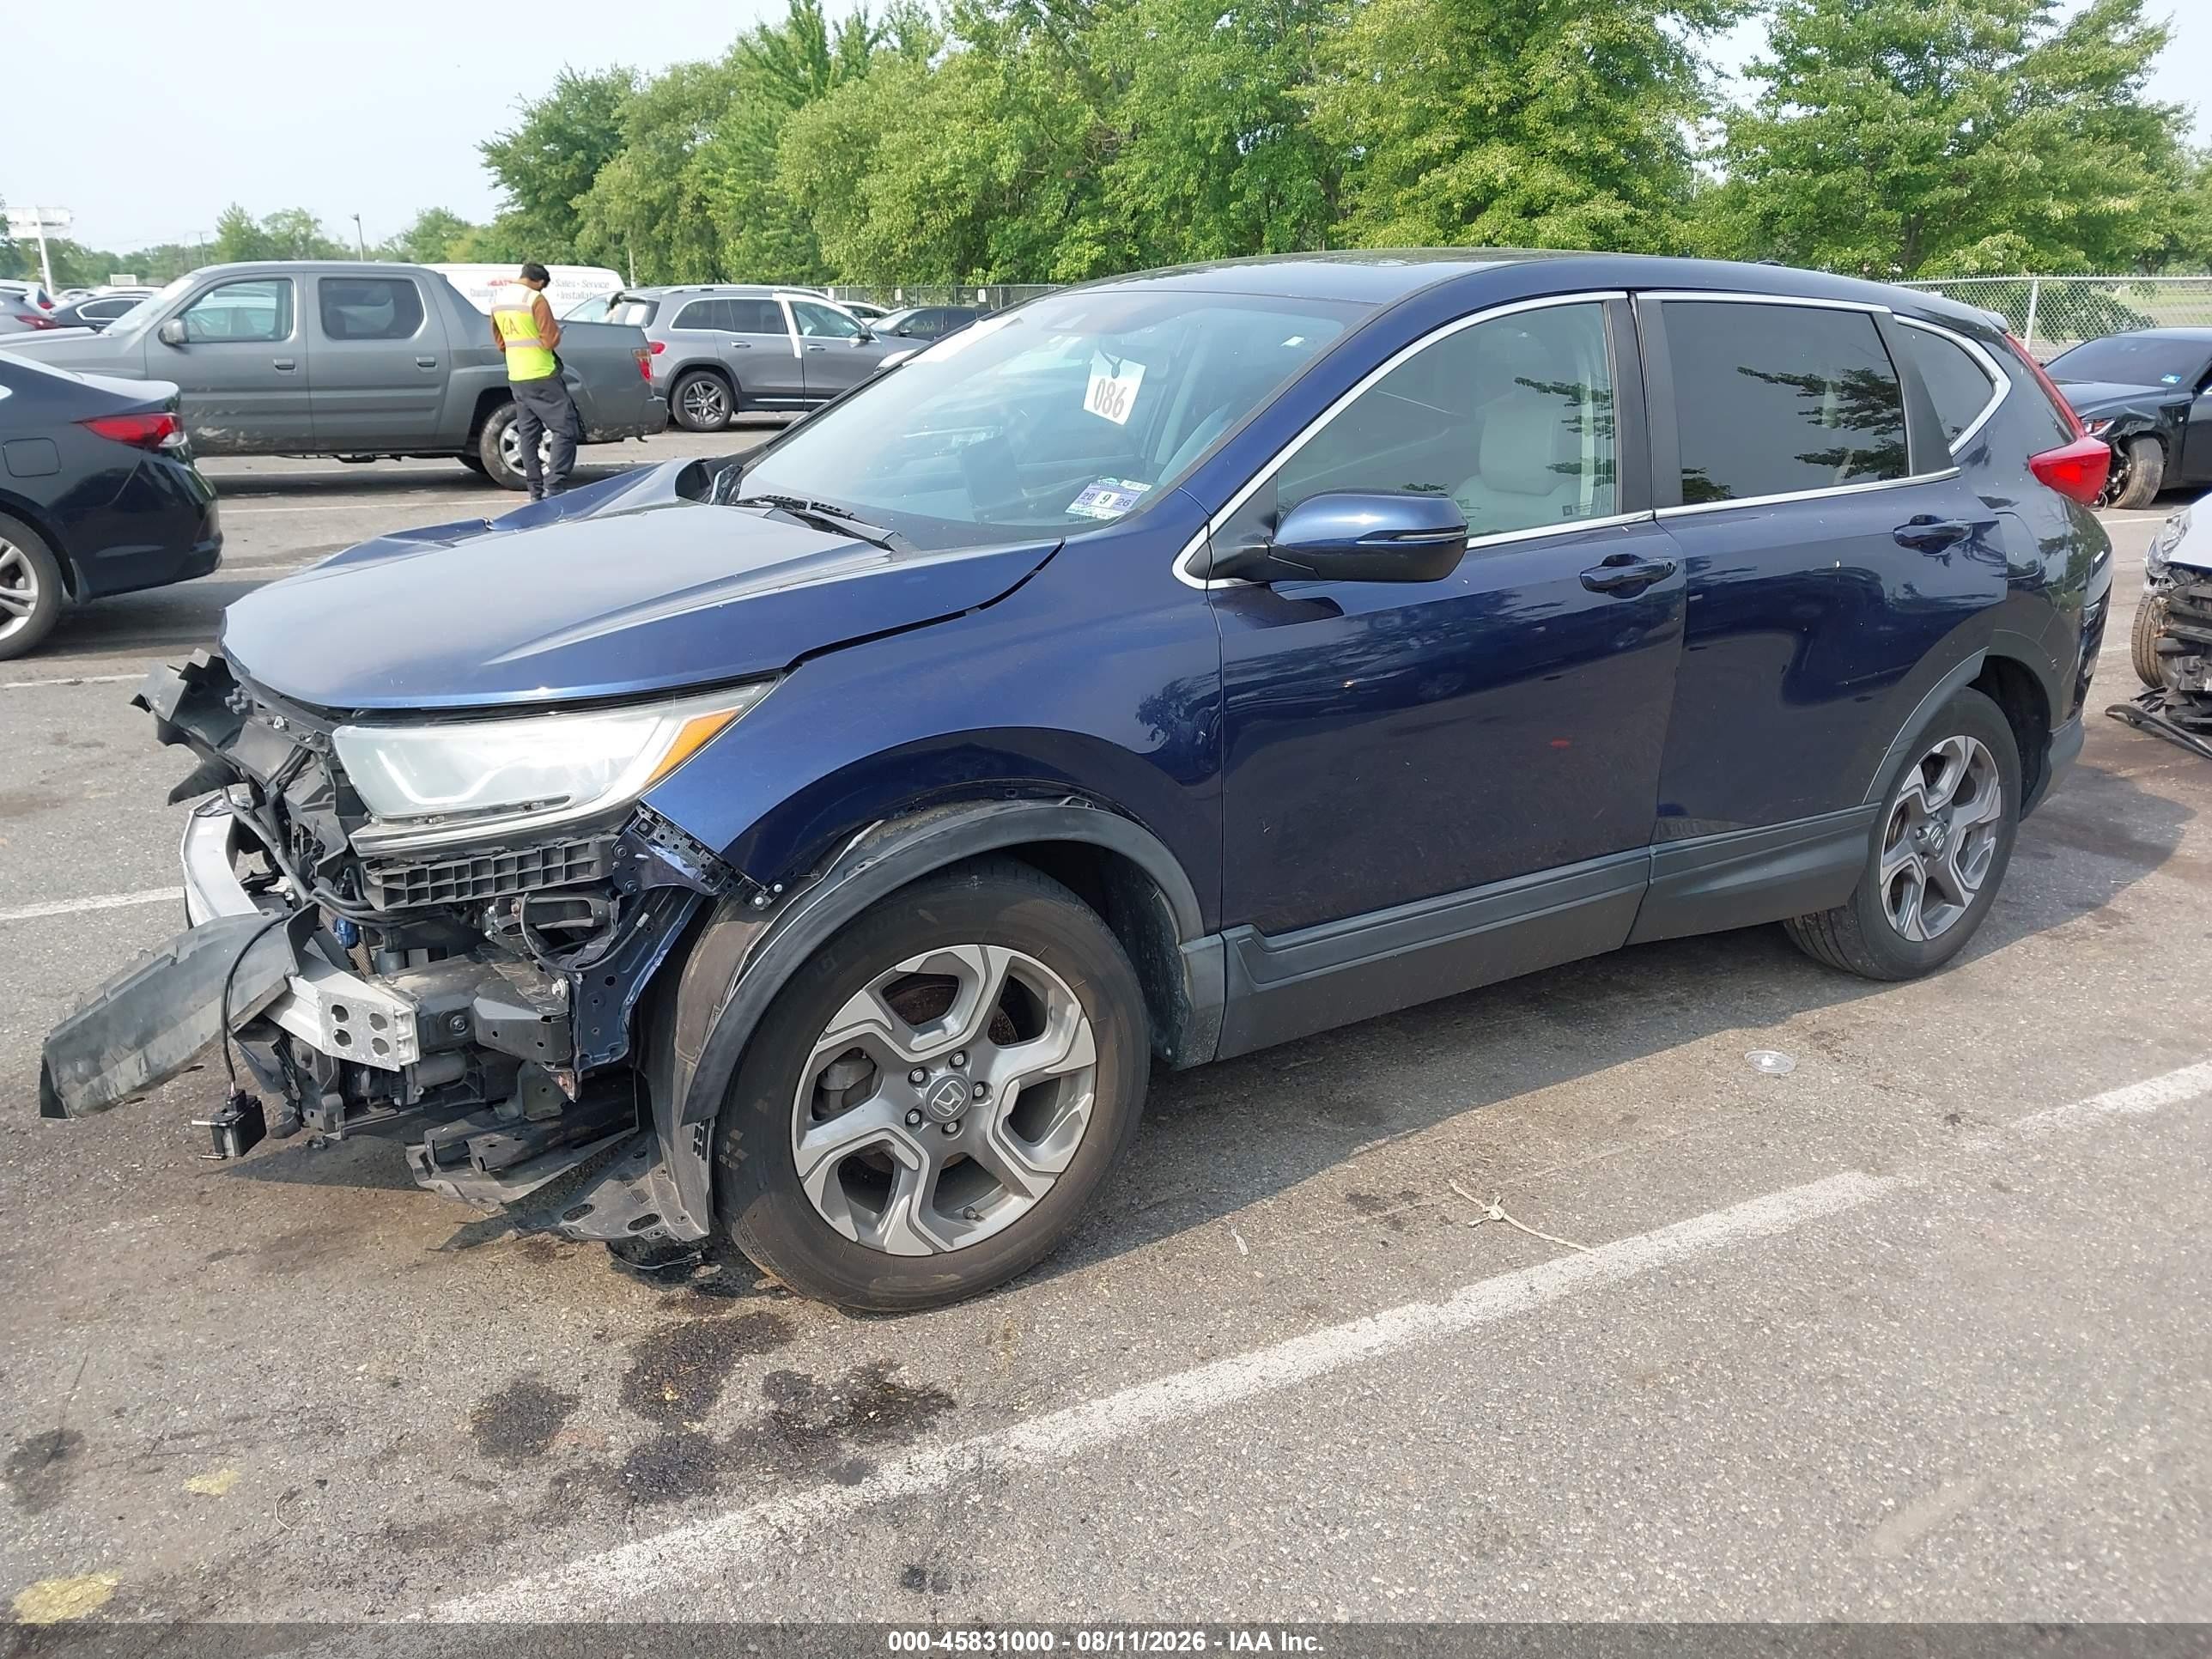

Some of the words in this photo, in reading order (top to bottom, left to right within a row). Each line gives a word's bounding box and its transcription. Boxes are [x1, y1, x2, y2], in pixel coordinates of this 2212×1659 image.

[555, 279, 576, 288] Sales
[581, 279, 611, 289] Service
[1093, 378, 1127, 418] 086
[1080, 492, 1096, 501] 20
[1099, 494, 1112, 504] 9
[1115, 498, 1132, 507] 26
